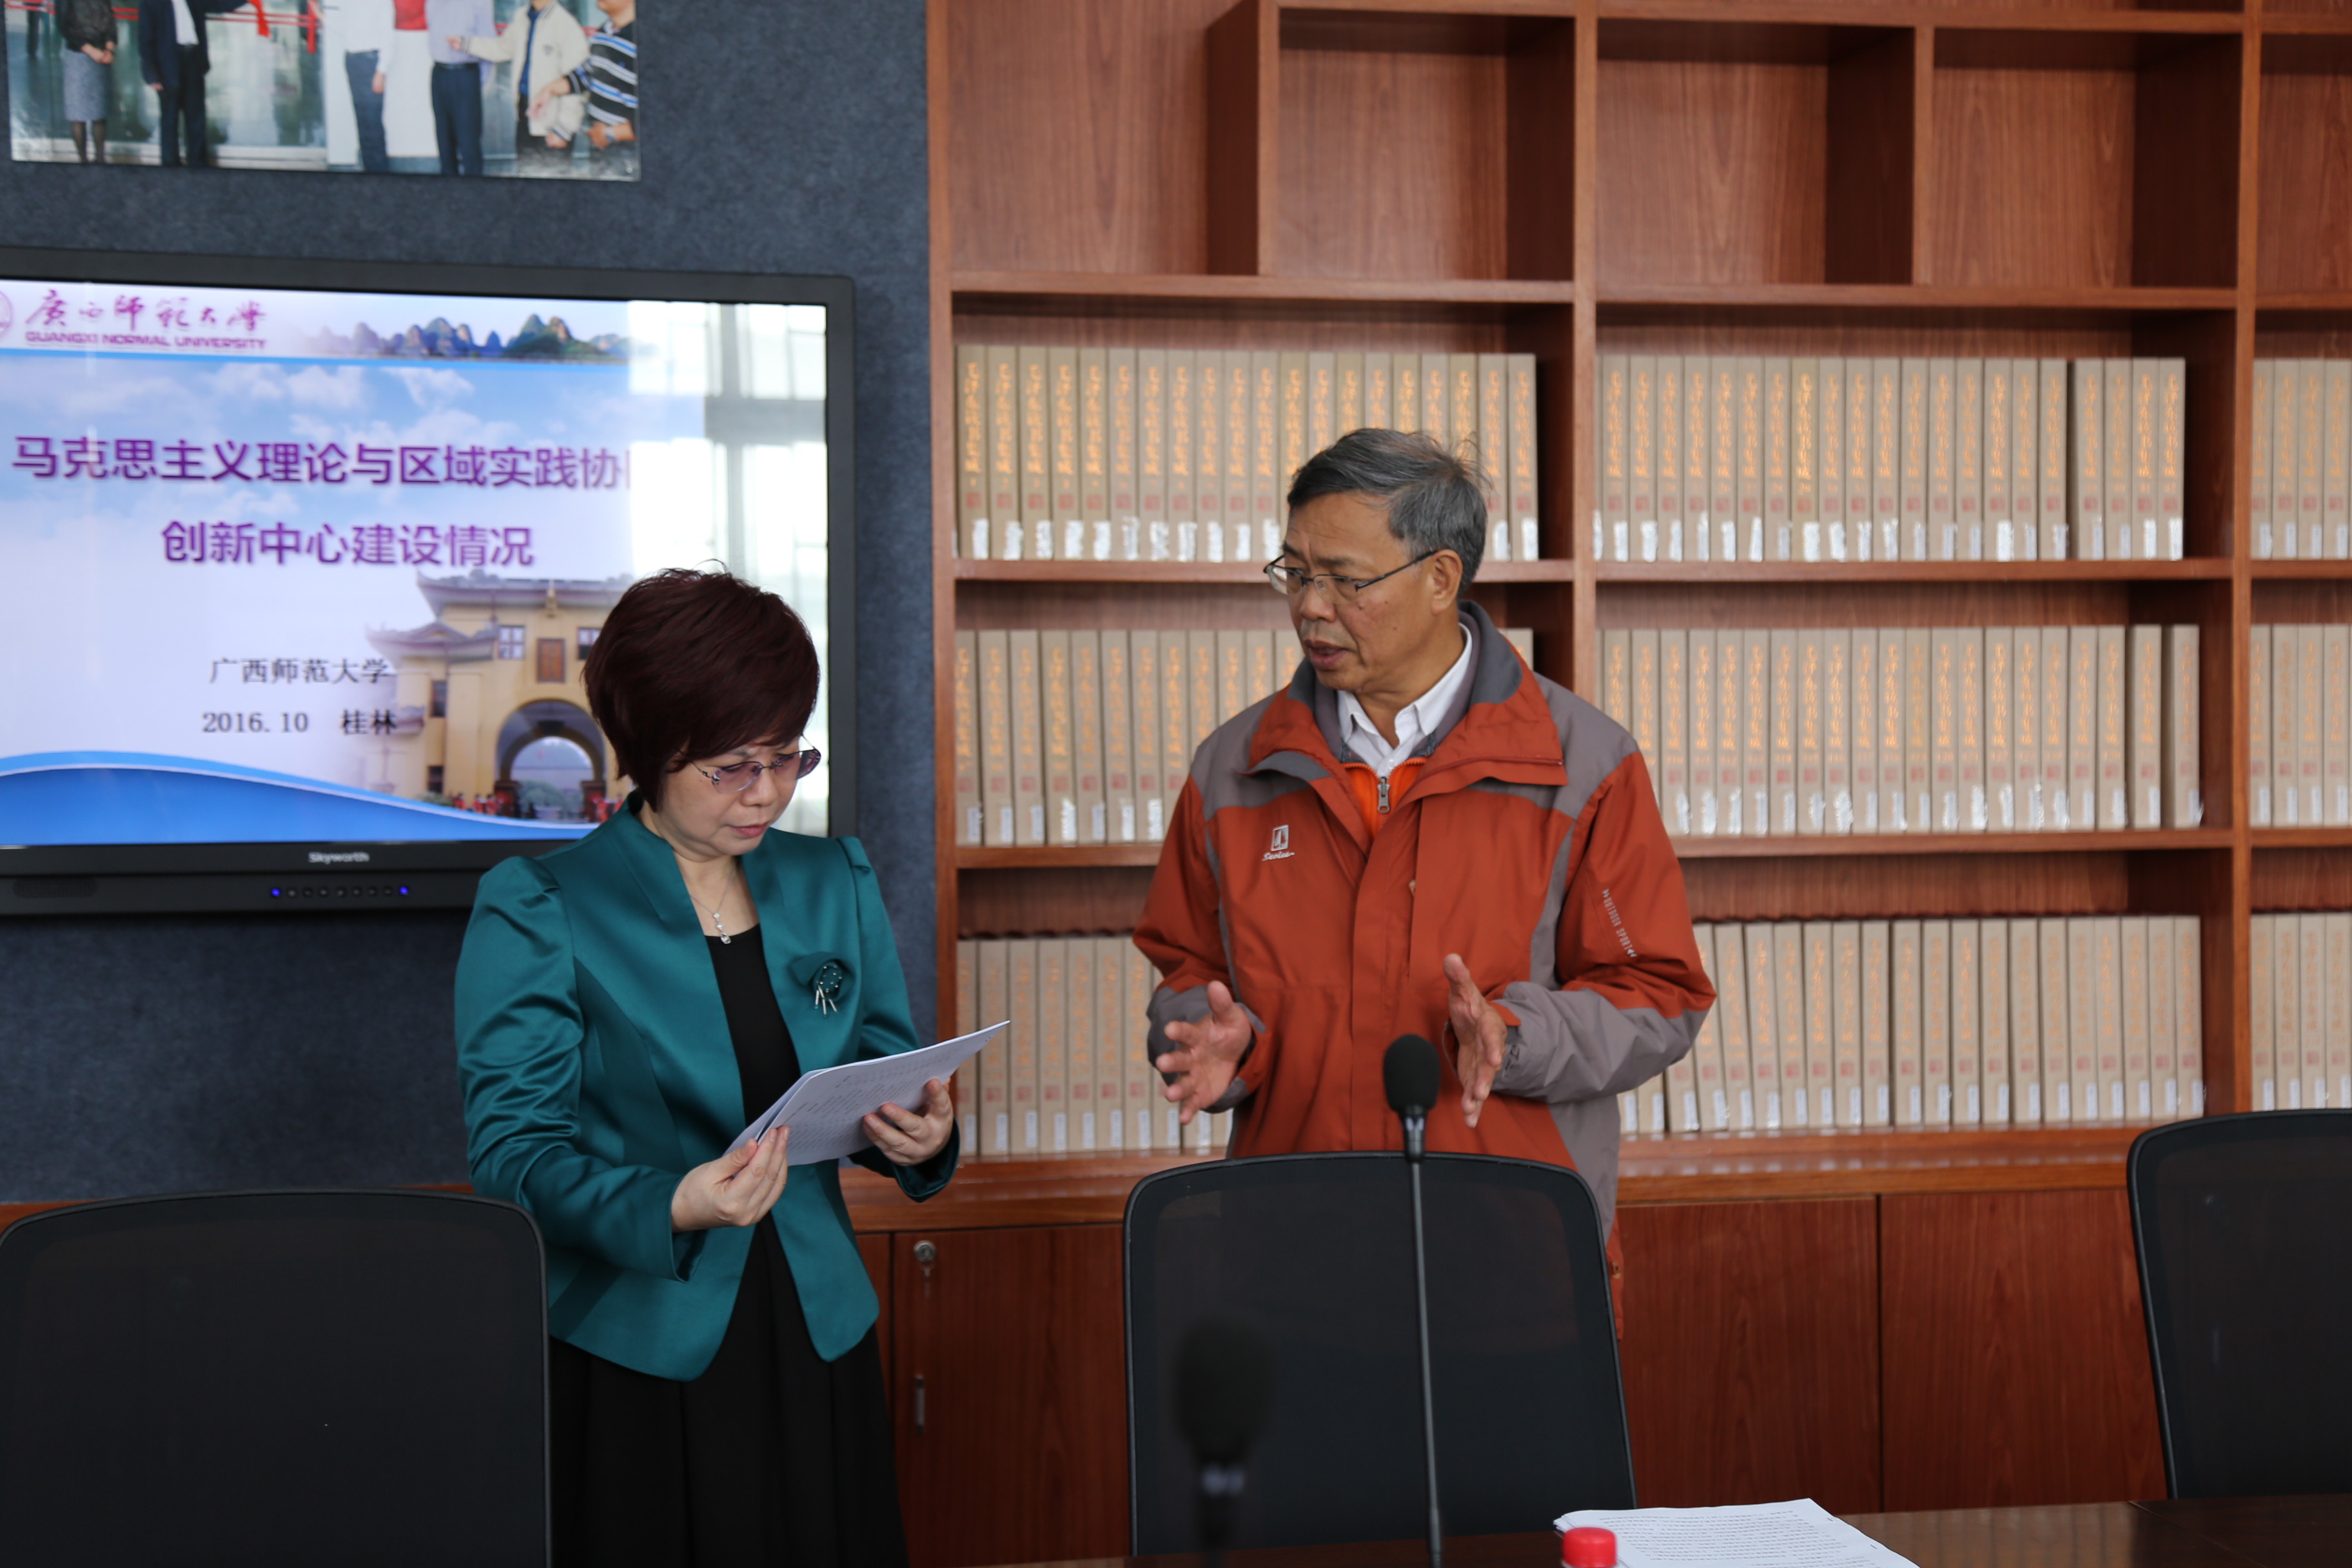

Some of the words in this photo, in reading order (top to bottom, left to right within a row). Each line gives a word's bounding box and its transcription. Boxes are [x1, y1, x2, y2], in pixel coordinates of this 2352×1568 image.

[25, 331, 99, 344] GUANGXI
[102, 334, 170, 347] NORMAL
[173, 337, 266, 349] UNIVERSITY
[12, 435, 631, 491] 马克思主义理论与区域实践协
[161, 518, 535, 568] 创新中心建设情况
[209, 656, 389, 685] 广西师范大学
[341, 708, 398, 737] 桂林
[308, 851, 370, 865] Skyworth
[1616, 927, 1633, 950] SPORT
